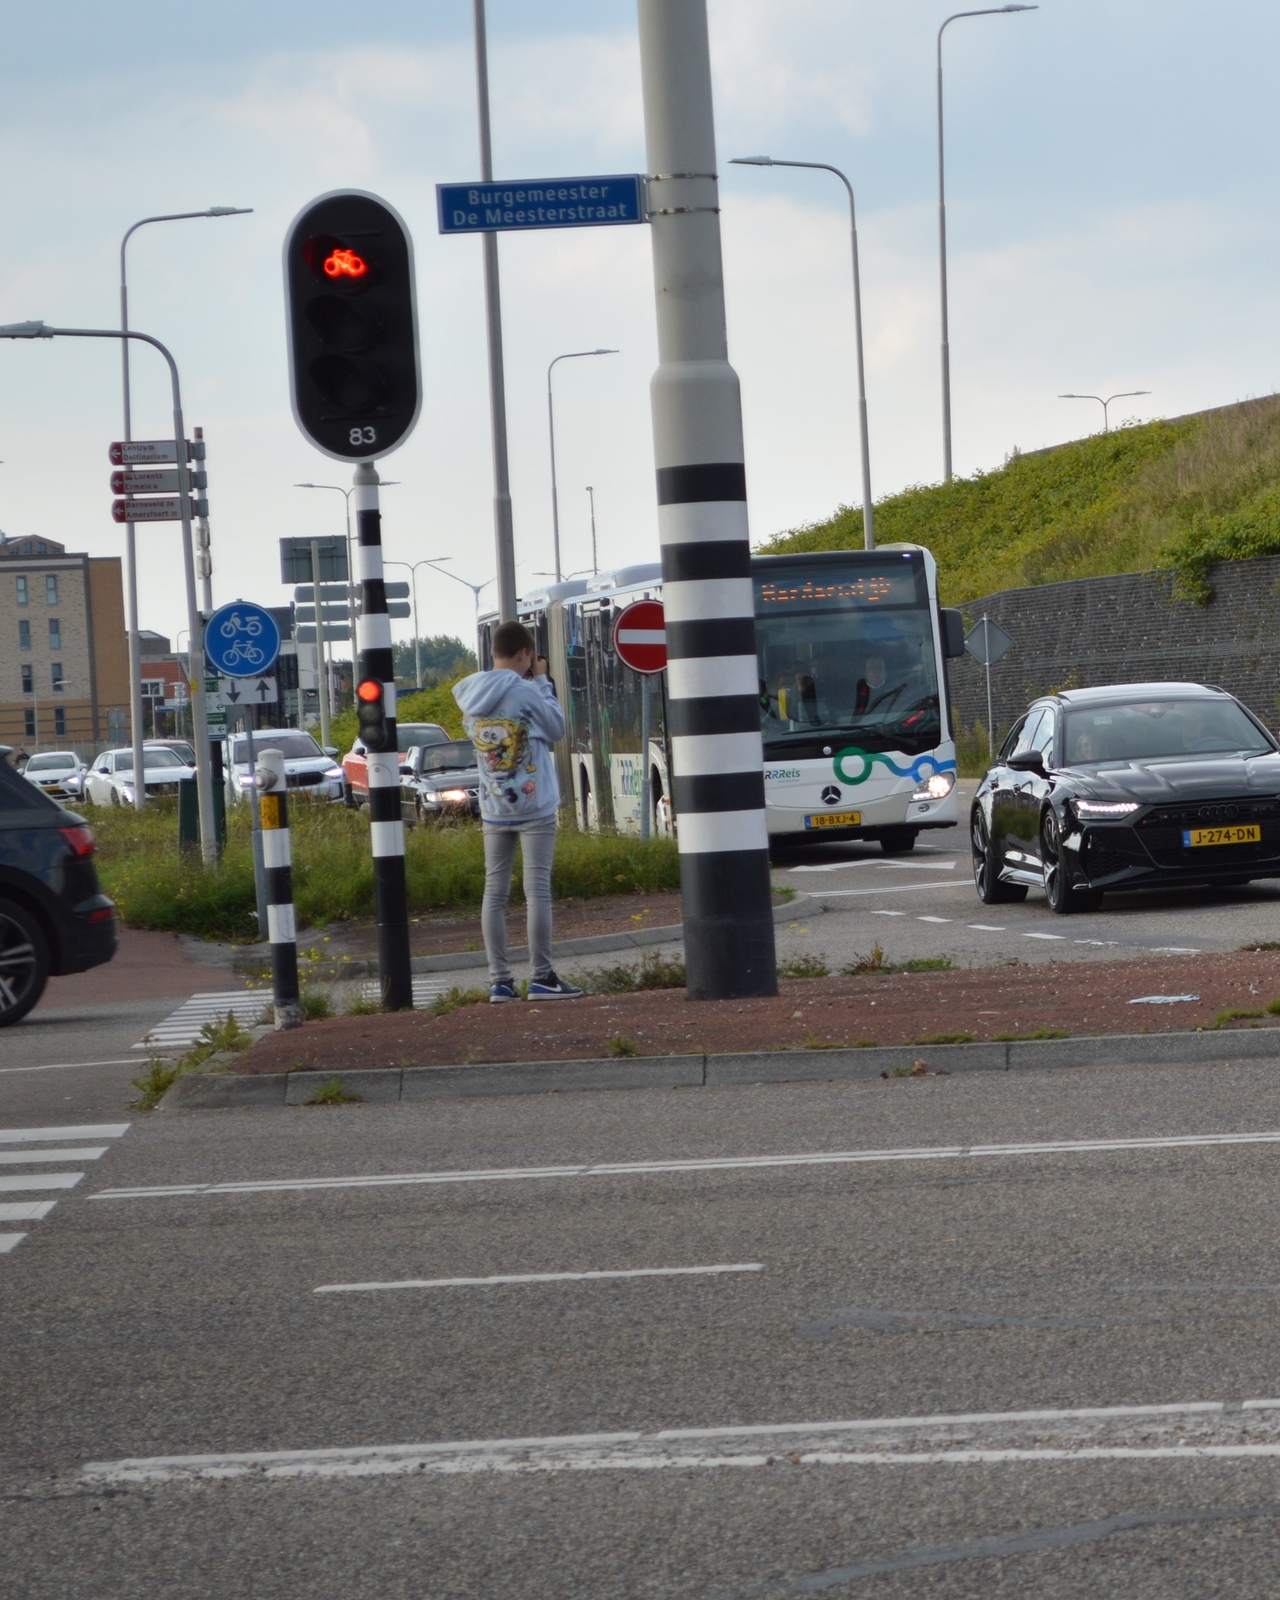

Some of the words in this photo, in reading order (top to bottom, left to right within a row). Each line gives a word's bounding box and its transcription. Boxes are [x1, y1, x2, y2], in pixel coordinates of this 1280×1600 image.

[468, 184, 609, 208] Burgemeester
[453, 210, 478, 226] De
[485, 203, 627, 224] Meesterstraat
[349, 426, 376, 445] 83
[123, 453, 168, 461] Dolfinarium
[125, 483, 152, 491] Ermelo
[126, 510, 169, 518] Amersfoort
[764, 768, 801, 780] RRReis
[814, 814, 855, 825] 18-BXJ-4
[1195, 827, 1256, 844] J-274-DN
